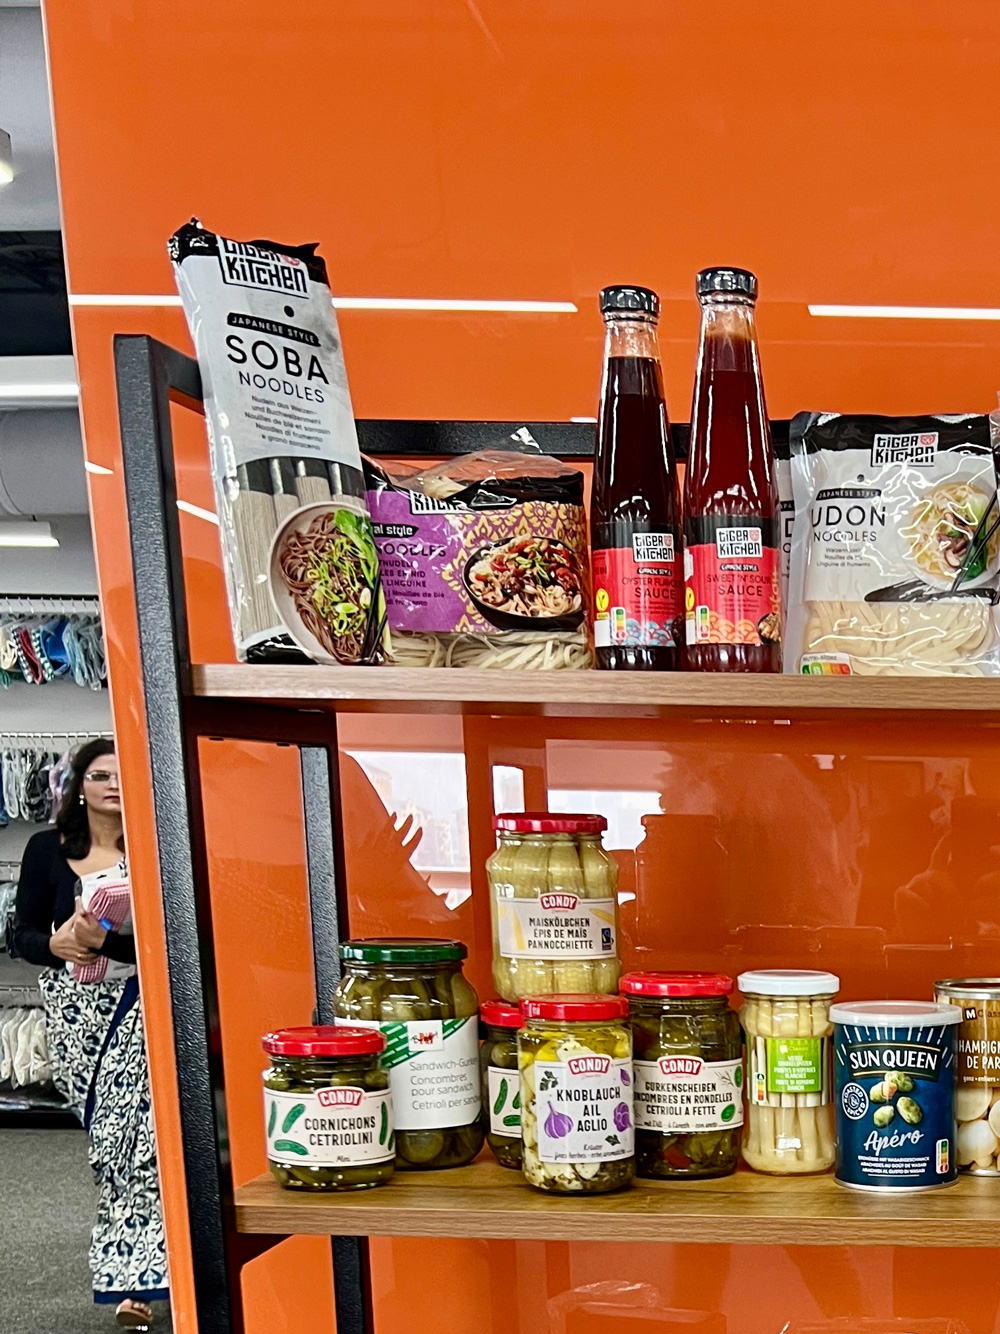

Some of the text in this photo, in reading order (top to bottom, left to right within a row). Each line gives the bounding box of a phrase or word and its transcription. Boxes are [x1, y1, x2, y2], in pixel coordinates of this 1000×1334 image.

[232, 317, 314, 343] JAPANESE STYLE
[226, 335, 329, 385] SOBA
[239, 371, 325, 403] NOODLES
[812, 506, 886, 526] UDON
[750, 575, 770, 583] SOUR
[635, 590, 676, 599] SAUCE
[719, 586, 762, 596] SAUCE
[542, 895, 577, 909] CONDY
[529, 917, 590, 927] MAISKÖLBCHEN
[554, 930, 564, 938] DE
[527, 939, 594, 949] PANNOCCHIETTE
[966, 1010, 976, 1019] M
[571, 1058, 609, 1074] CONDY
[850, 1050, 937, 1070] SUN QUEEN
[967, 1057, 978, 1068] DE
[663, 1061, 700, 1074] CONDY
[411, 1074, 468, 1086] Concombres
[412, 1088, 434, 1097] pour
[646, 1082, 716, 1092] GURKENSCHEIBEN
[321, 1091, 361, 1105] CONDY
[557, 1086, 621, 1102] KNOBLAUCH
[681, 1092, 732, 1104] EN RONDELLES
[412, 1099, 462, 1110] Cetrioli per
[584, 1103, 601, 1116] AIL
[647, 1106, 682, 1115] CETRIOLI
[693, 1106, 716, 1115] FETTE
[305, 1116, 375, 1131] CORNICHONS
[577, 1118, 607, 1132] AGLIO
[309, 1131, 373, 1146] CETRIOLINI
[864, 1130, 924, 1156] Apéro
